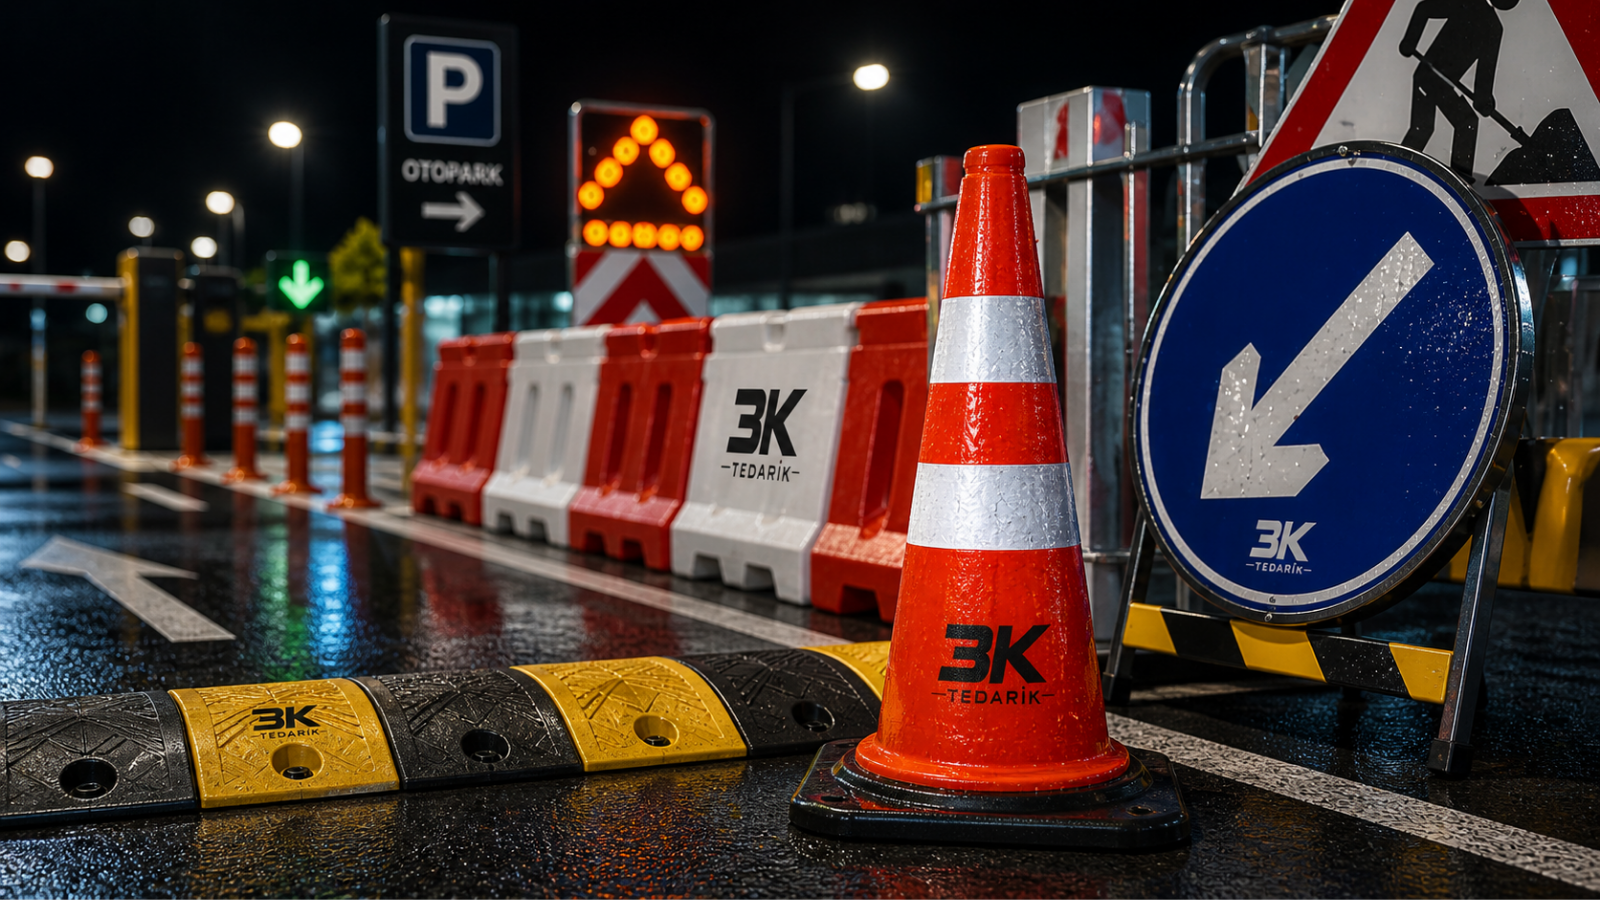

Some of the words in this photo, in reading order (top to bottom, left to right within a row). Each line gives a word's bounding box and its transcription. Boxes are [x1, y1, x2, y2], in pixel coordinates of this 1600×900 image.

[426, 50, 484, 129] P
[401, 158, 504, 186] OTOPARK
[726, 389, 808, 457] 3K
[1249, 519, 1317, 562] 3K
[938, 623, 1051, 684] 3K
[252, 704, 321, 731] 3K
